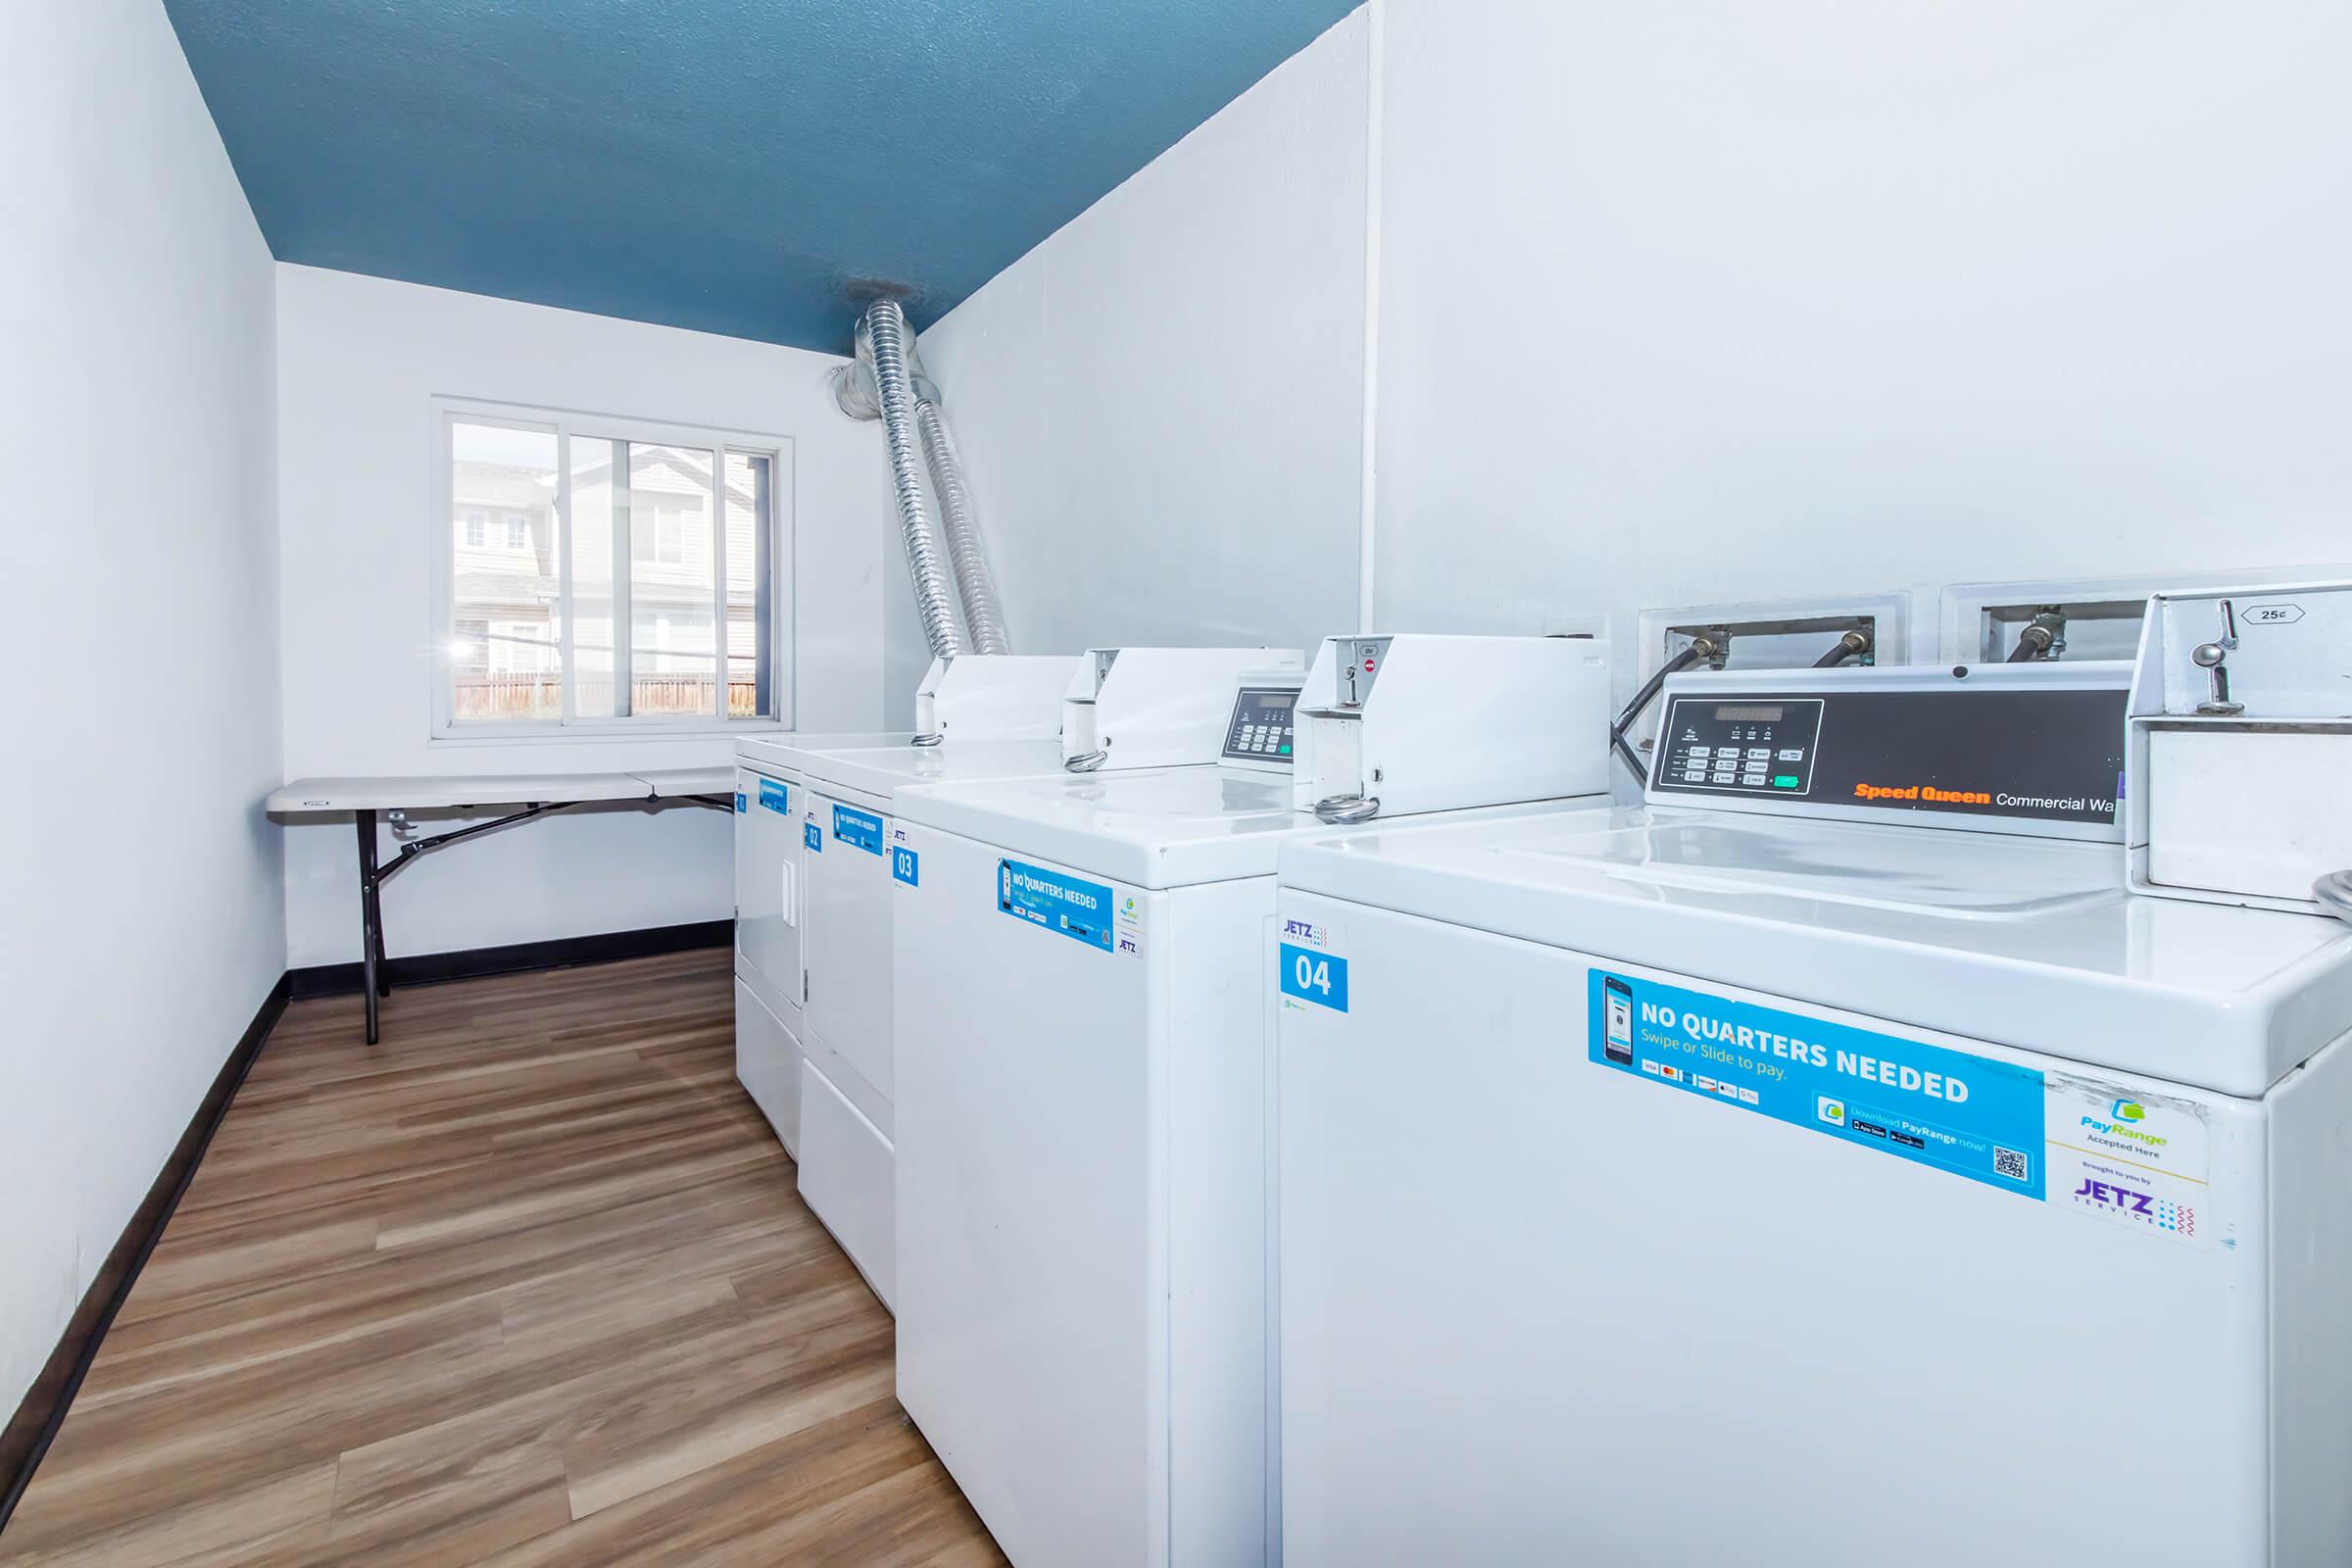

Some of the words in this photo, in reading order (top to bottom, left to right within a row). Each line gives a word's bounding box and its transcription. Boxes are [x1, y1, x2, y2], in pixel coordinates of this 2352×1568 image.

[2261, 611, 2286, 619] 25¢
[1855, 783, 1918, 801] Speed
[1922, 787, 1991, 805] Queen
[1996, 793, 2084, 810] Commercial
[809, 828, 818, 847] 02
[899, 852, 912, 879] 03
[1013, 872, 1023, 887] NO
[1024, 874, 1064, 900] QUARTERS
[1064, 889, 1097, 910] NEEDED
[1284, 919, 1312, 939] JETZ
[1296, 955, 1332, 996] 04
[1641, 1028, 1680, 1050] Swipe
[1683, 1042, 1697, 1054] or
[1700, 1042, 1734, 1065] Slide
[1738, 1054, 1753, 1070] to
[1756, 1061, 1788, 1083] pay.
[1642, 1002, 1676, 1028] NO
[1682, 1012, 1828, 1067] QUARTERS
[1837, 1050, 1969, 1103] NEEDED
[1851, 1106, 1900, 1128] Download
[1902, 1121, 1957, 1145] PayRange
[1959, 1138, 1986, 1152] now!
[2080, 1115, 2168, 1146] PayRange
[2087, 1134, 2133, 1152] Accepted
[2134, 1146, 2160, 1158] Here
[2082, 1160, 2114, 1175] Brought
[2126, 1173, 2140, 1183] you
[2140, 1177, 2151, 1186] by
[2074, 1178, 2154, 1216] JETZ
[2074, 1196, 2154, 1225] SERVICE
